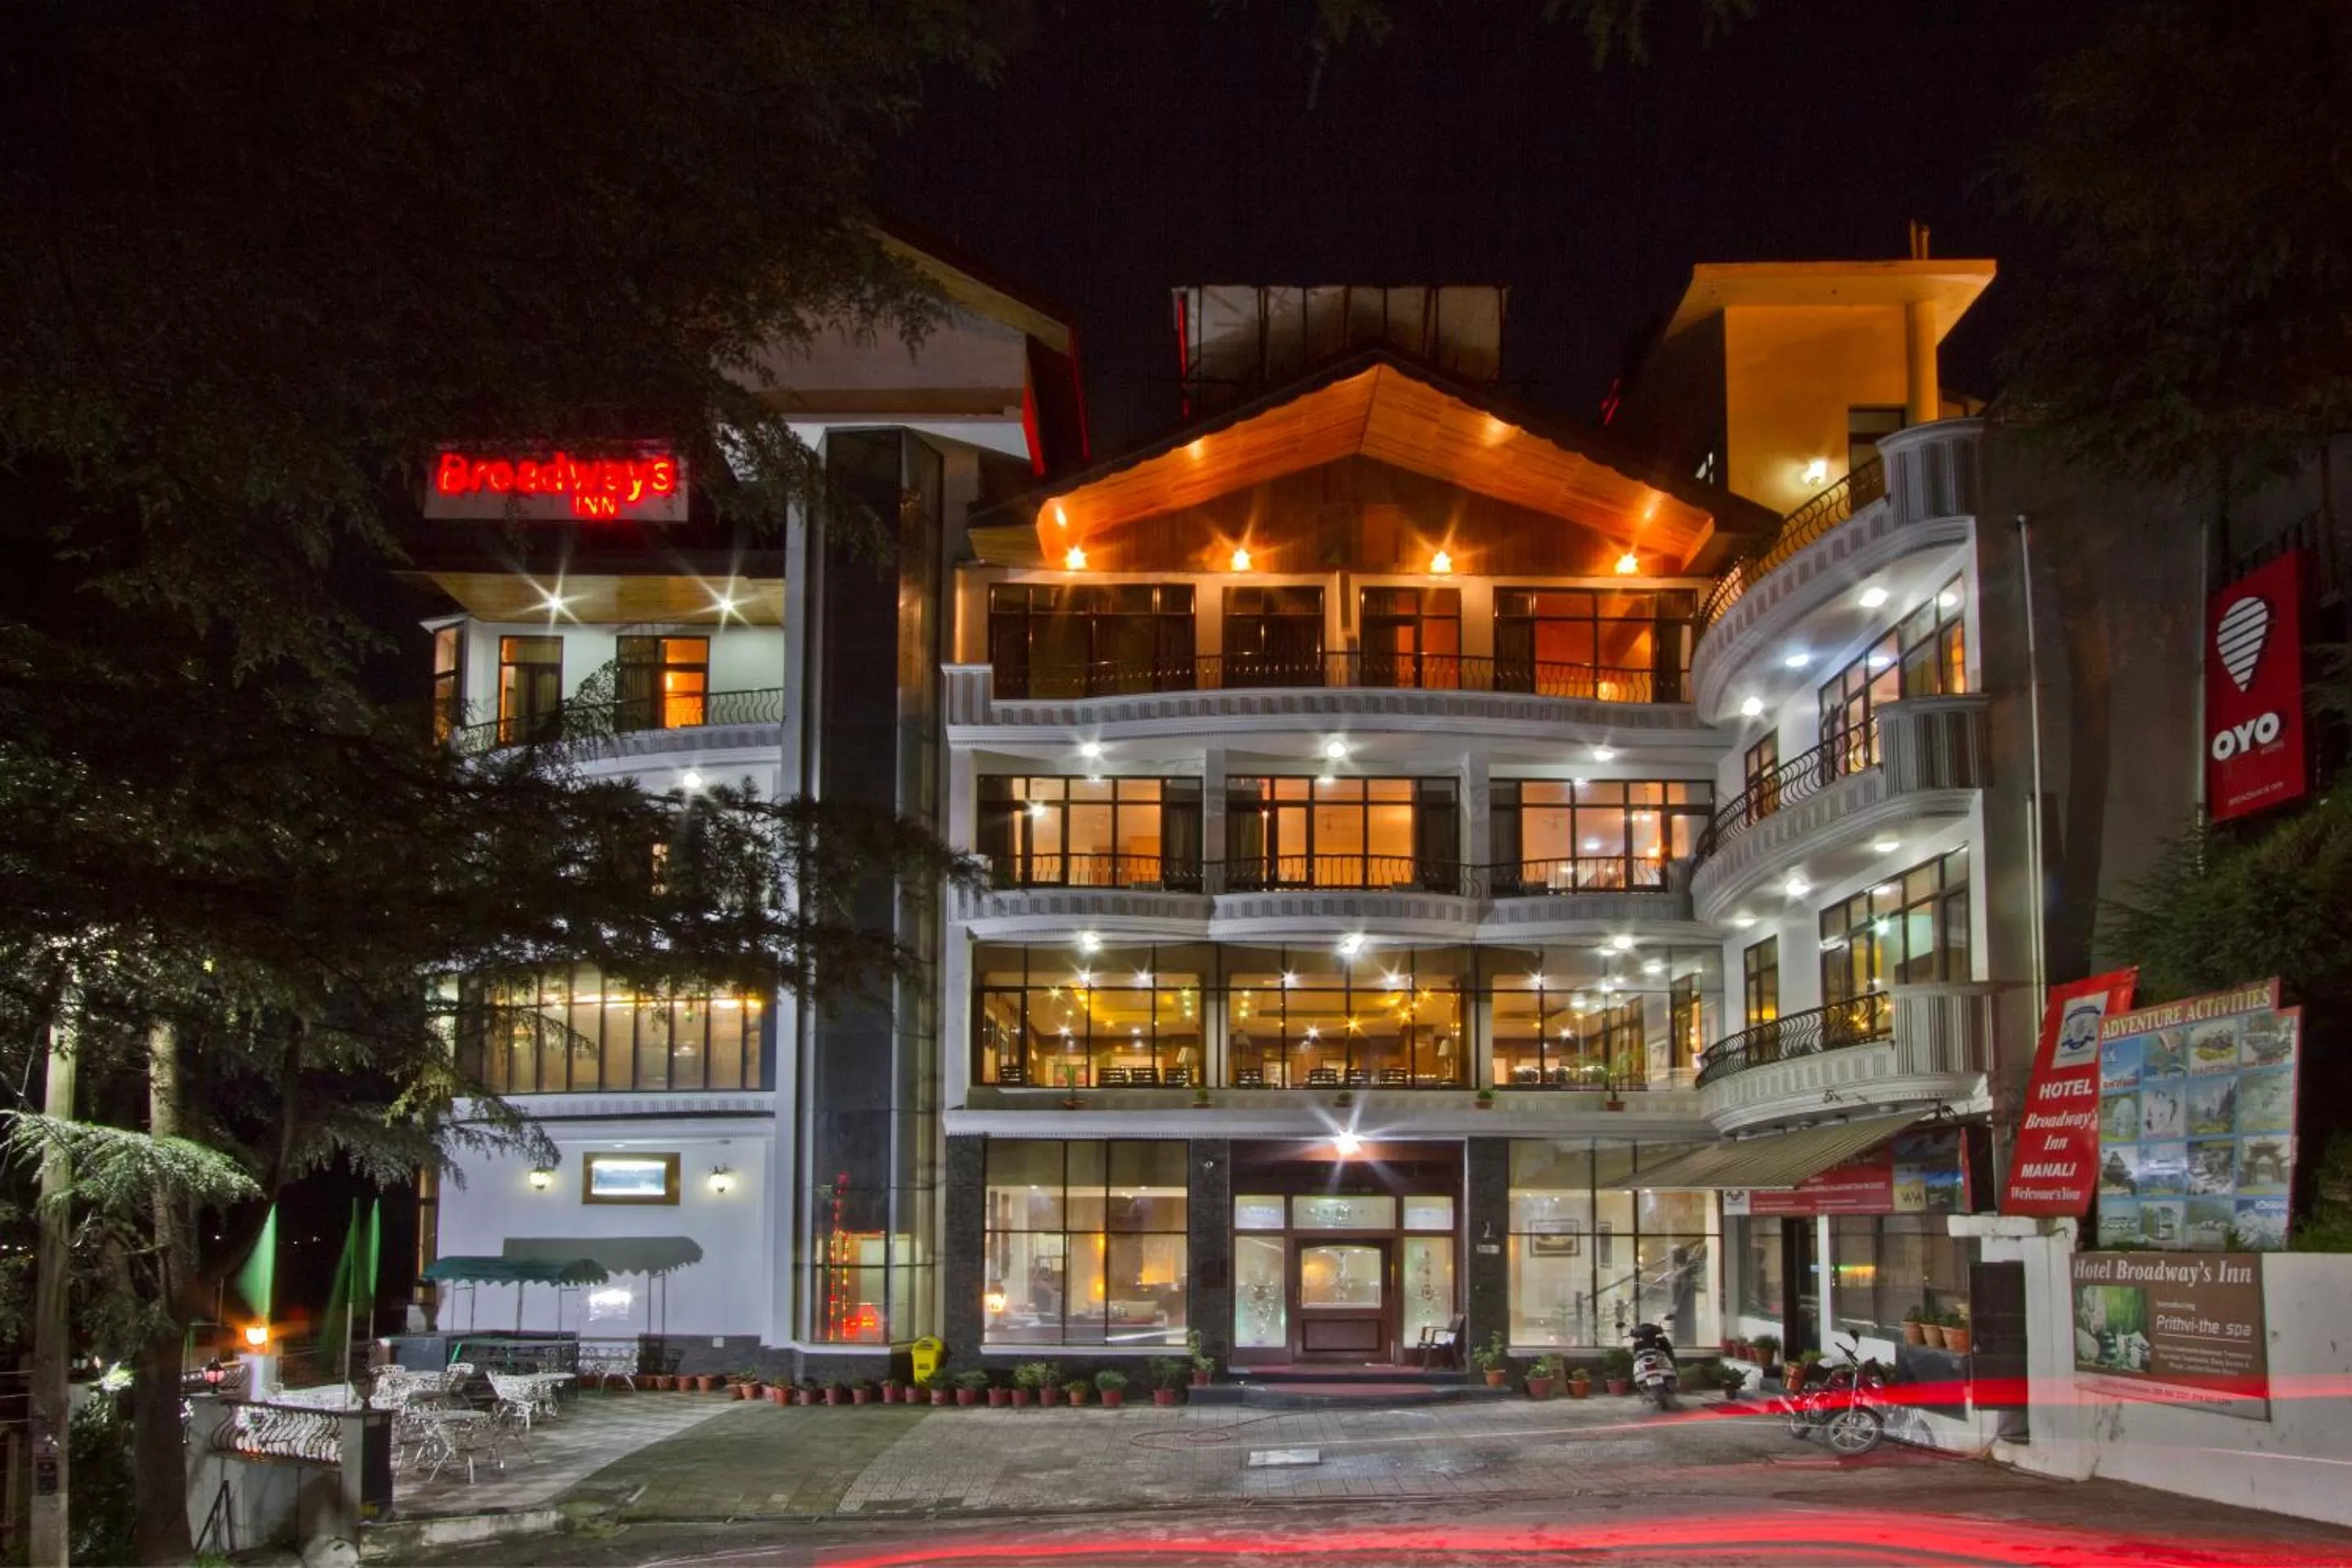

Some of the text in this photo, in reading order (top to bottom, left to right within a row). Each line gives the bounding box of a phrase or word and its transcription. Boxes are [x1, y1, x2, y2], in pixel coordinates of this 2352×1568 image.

[575, 496, 616, 515] INN
[2212, 711, 2280, 762] OYO
[2101, 986, 2271, 1040] ADVENTURE ACTIVITIES
[2038, 1078, 2092, 1100] HOTEL
[2044, 1134, 2068, 1151] Inn
[2021, 1162, 2077, 1178] MANALI
[2074, 1259, 2252, 1288] Hotel Broadway's Inn
[2225, 1323, 2252, 1338] spa
